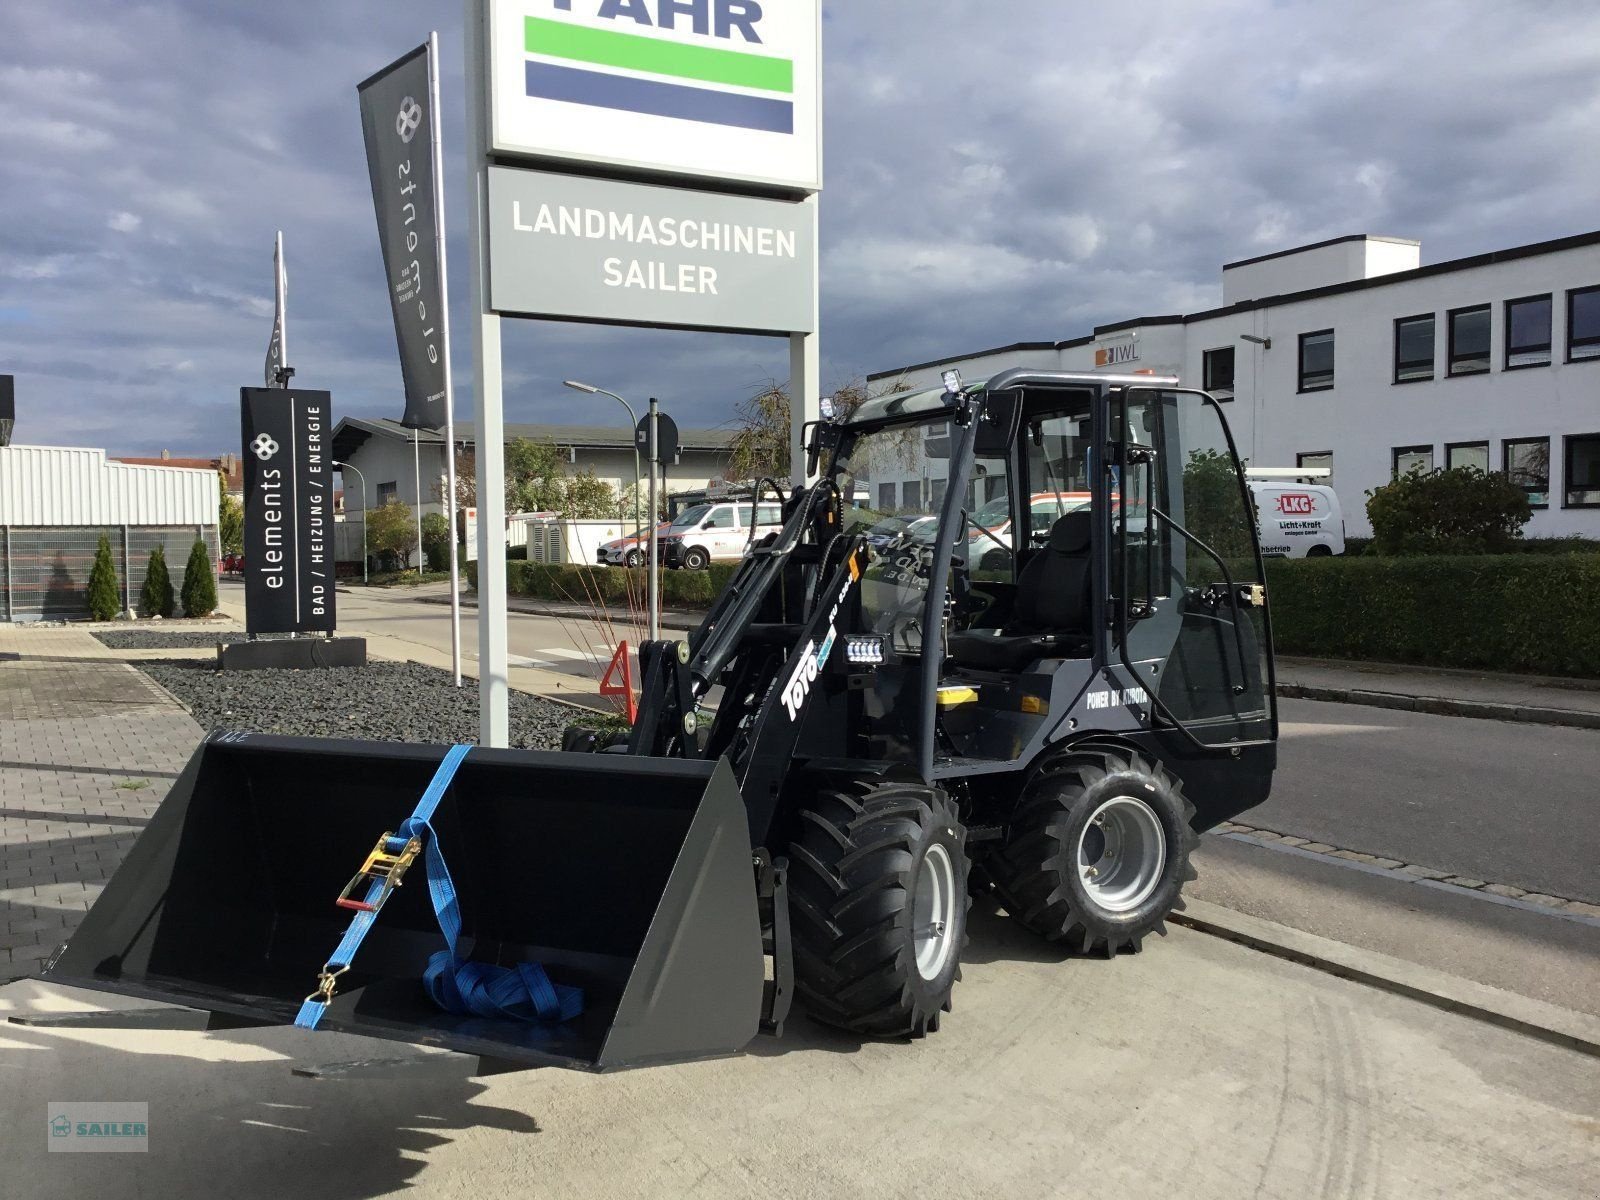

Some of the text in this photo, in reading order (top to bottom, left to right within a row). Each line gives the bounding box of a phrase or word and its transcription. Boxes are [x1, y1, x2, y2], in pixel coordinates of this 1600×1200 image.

[553, 0, 763, 44] AHR
[512, 200, 796, 258] LANDMASCHINEN
[603, 257, 719, 295] SAILER
[307, 406, 322, 473] ENERGIE
[1282, 497, 1309, 512] LKG
[260, 468, 284, 589] elements
[310, 494, 324, 563] HEIZUNG
[1260, 545, 1291, 553] hbetrieb
[312, 585, 325, 615] BAD
[1086, 687, 1148, 710] POWER BY KUBOTA
